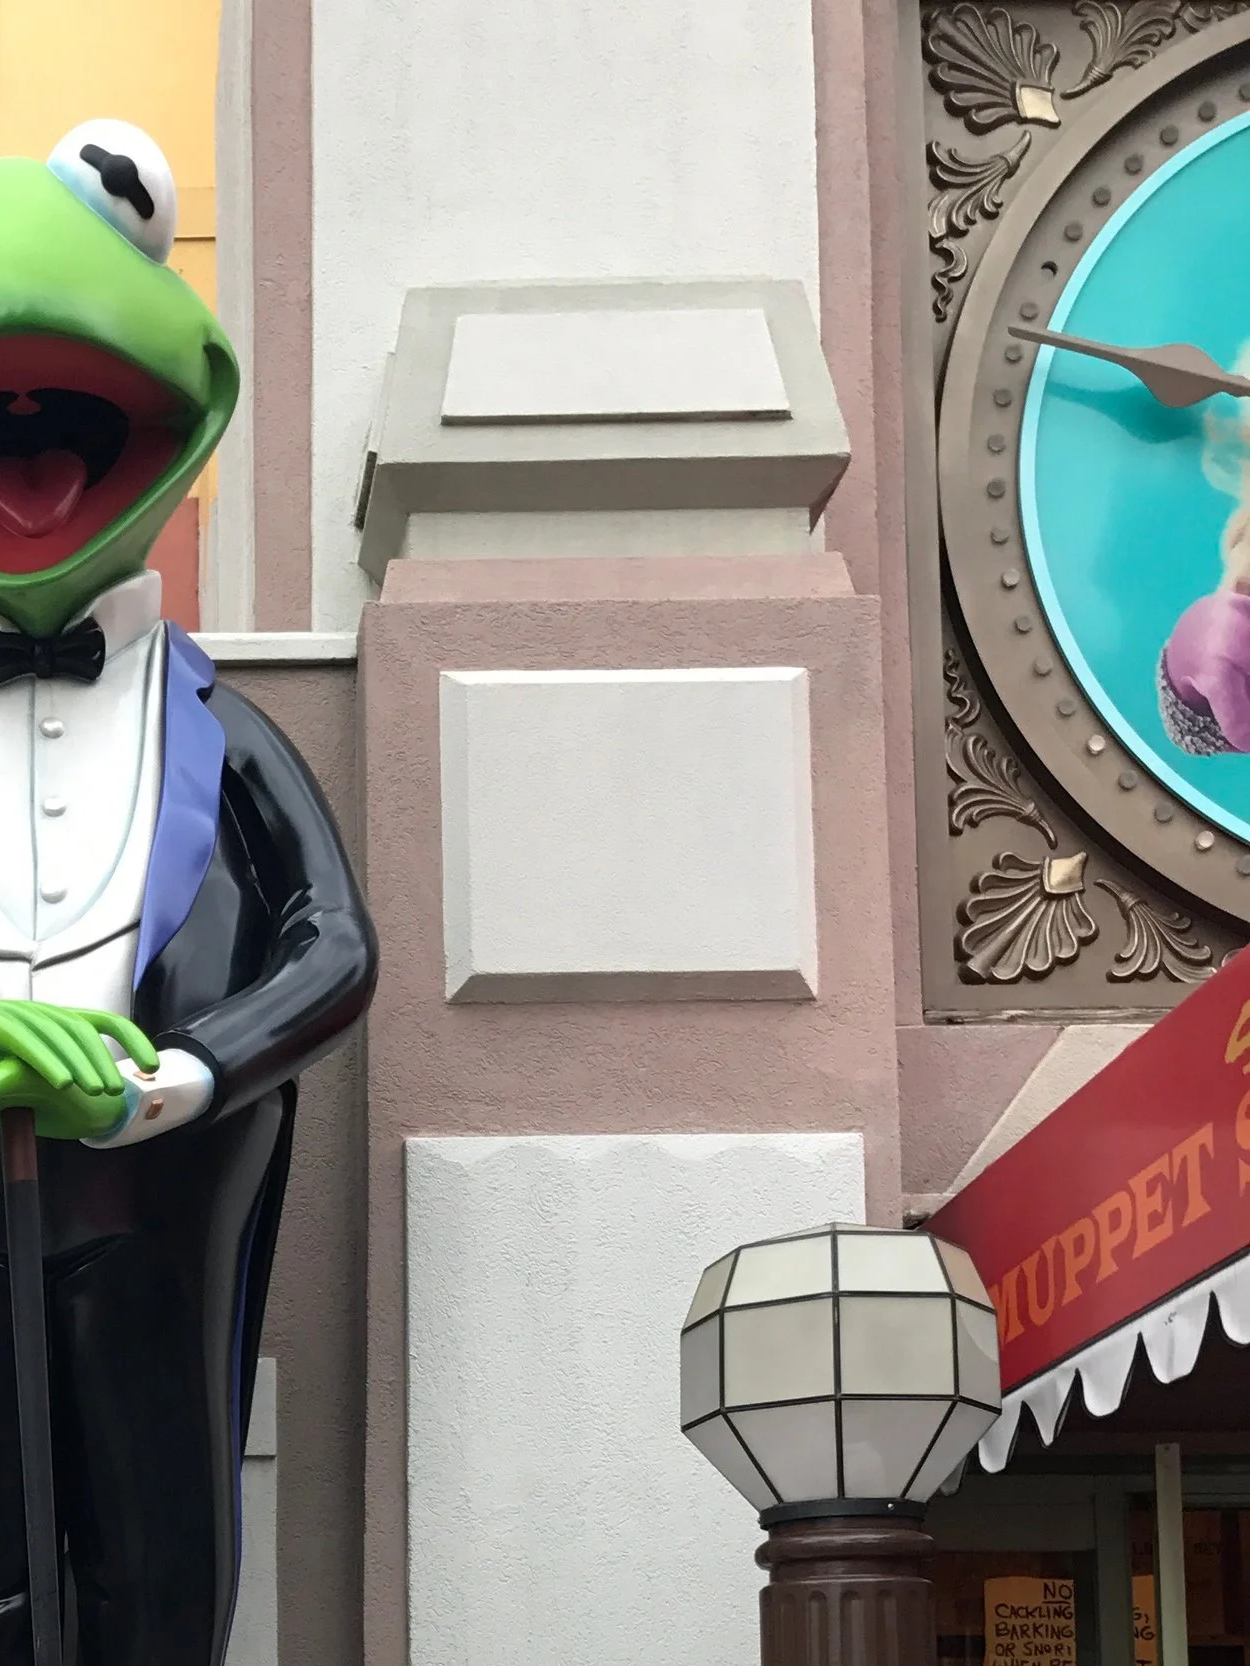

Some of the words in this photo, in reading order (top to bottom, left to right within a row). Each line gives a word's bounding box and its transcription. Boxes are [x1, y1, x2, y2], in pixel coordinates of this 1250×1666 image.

[989, 1121, 1215, 1345] MUPPET
[1043, 1581, 1073, 1600] NO
[994, 1603, 1073, 1620] CACKLING
[994, 1621, 1074, 1640] BARKING
[994, 1642, 1016, 1657] OR
[1022, 1641, 1072, 1657] SNORI
